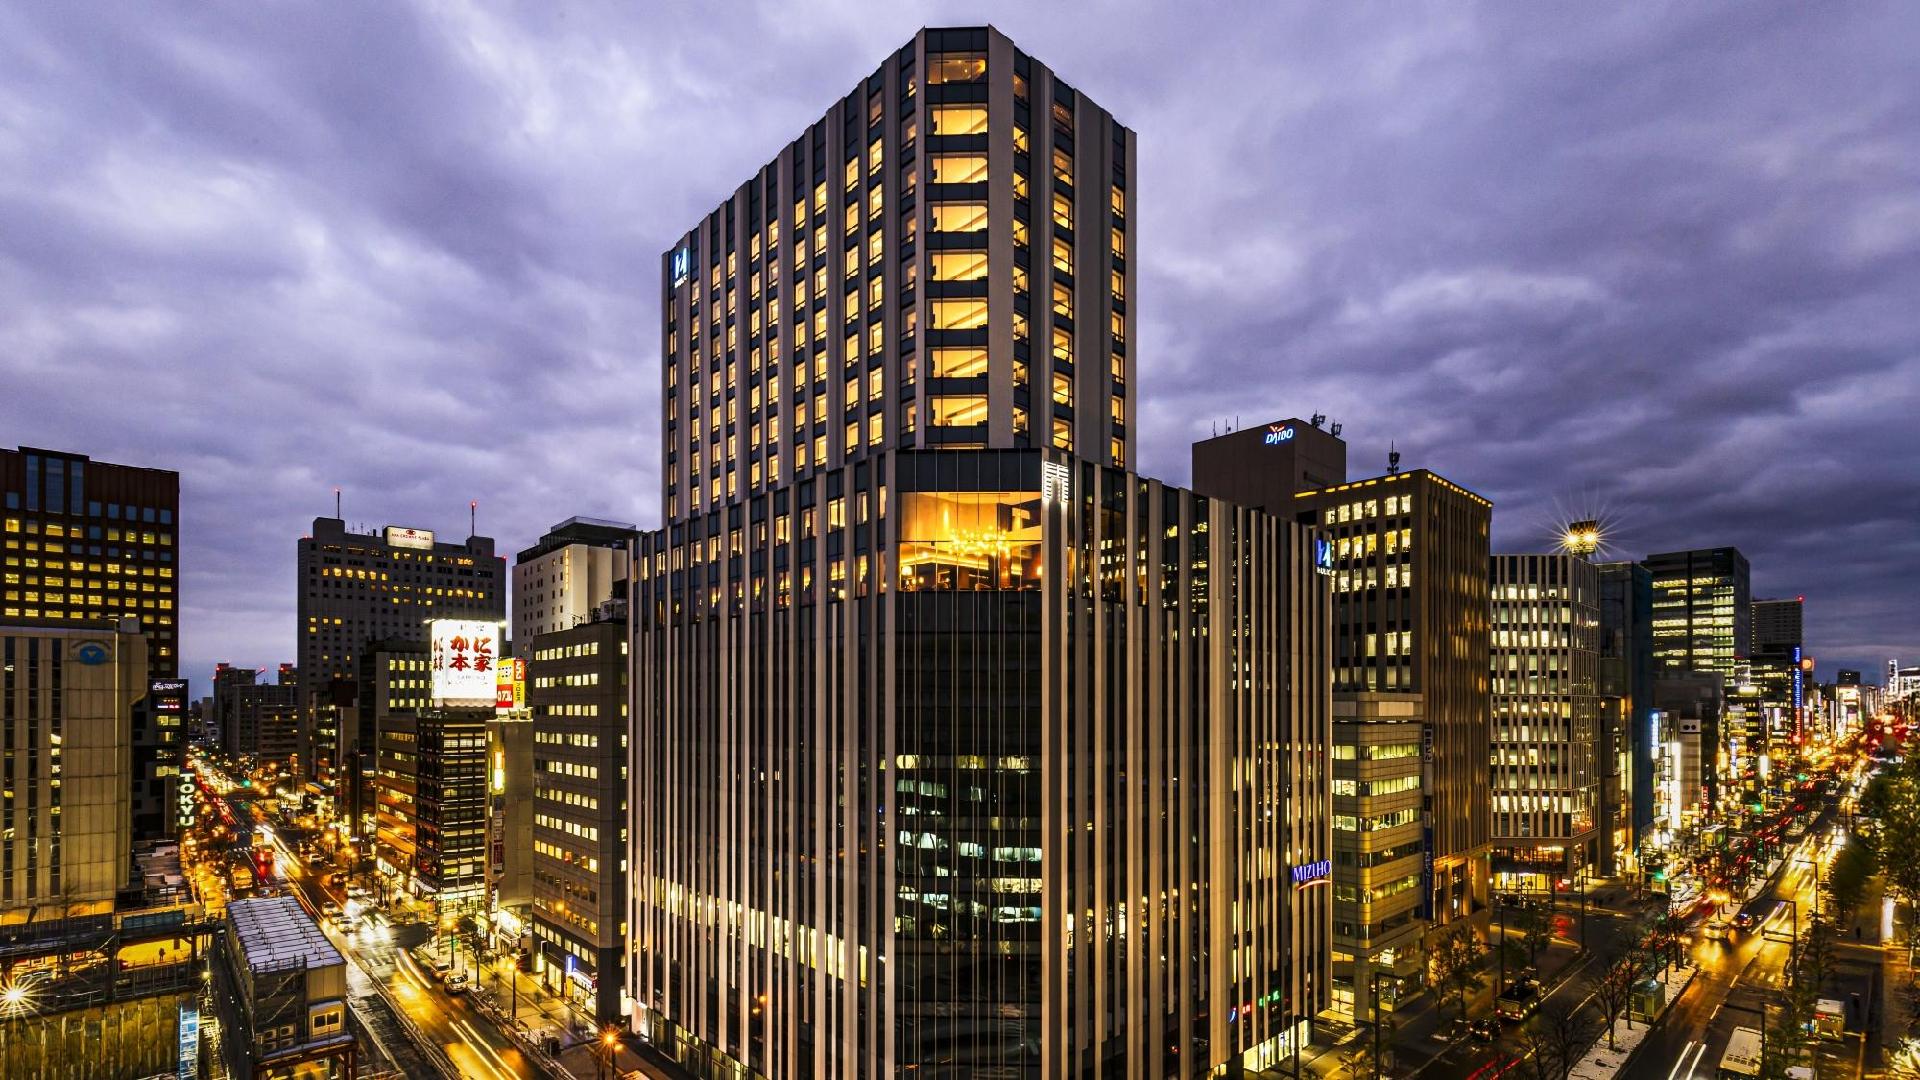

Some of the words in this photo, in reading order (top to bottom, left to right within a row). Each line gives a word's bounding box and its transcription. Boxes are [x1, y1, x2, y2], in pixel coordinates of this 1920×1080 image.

[1265, 428, 1294, 445] DAIDO
[450, 635, 492, 655] かに
[448, 653, 493, 672] 本家
[180, 773, 195, 826] TOKYU
